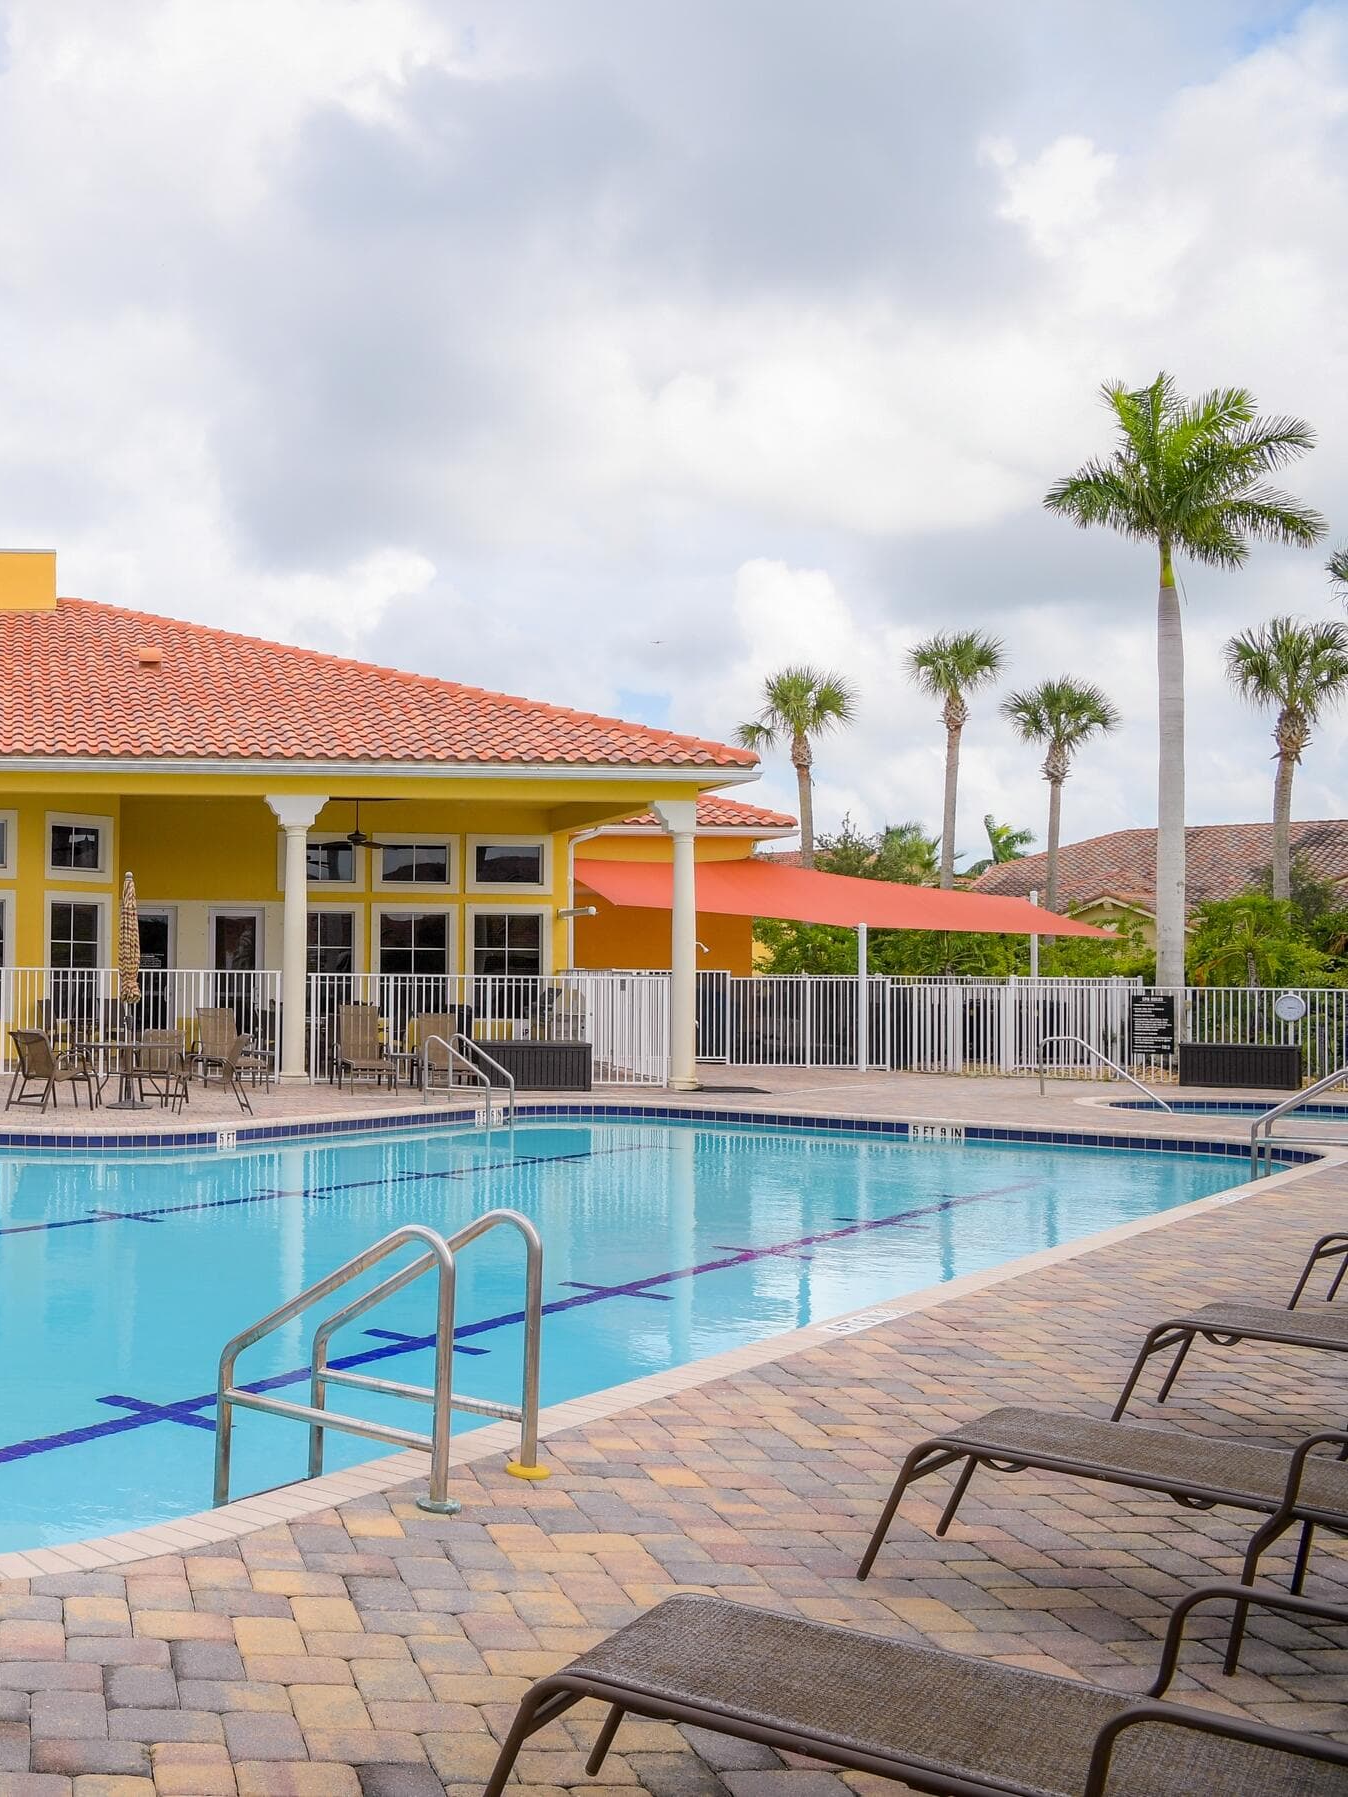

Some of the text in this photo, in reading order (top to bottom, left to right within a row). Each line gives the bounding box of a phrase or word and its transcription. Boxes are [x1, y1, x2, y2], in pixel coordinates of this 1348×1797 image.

[913, 1125, 962, 1137] 5 FT 9 IN
[227, 1132, 235, 1143] FT
